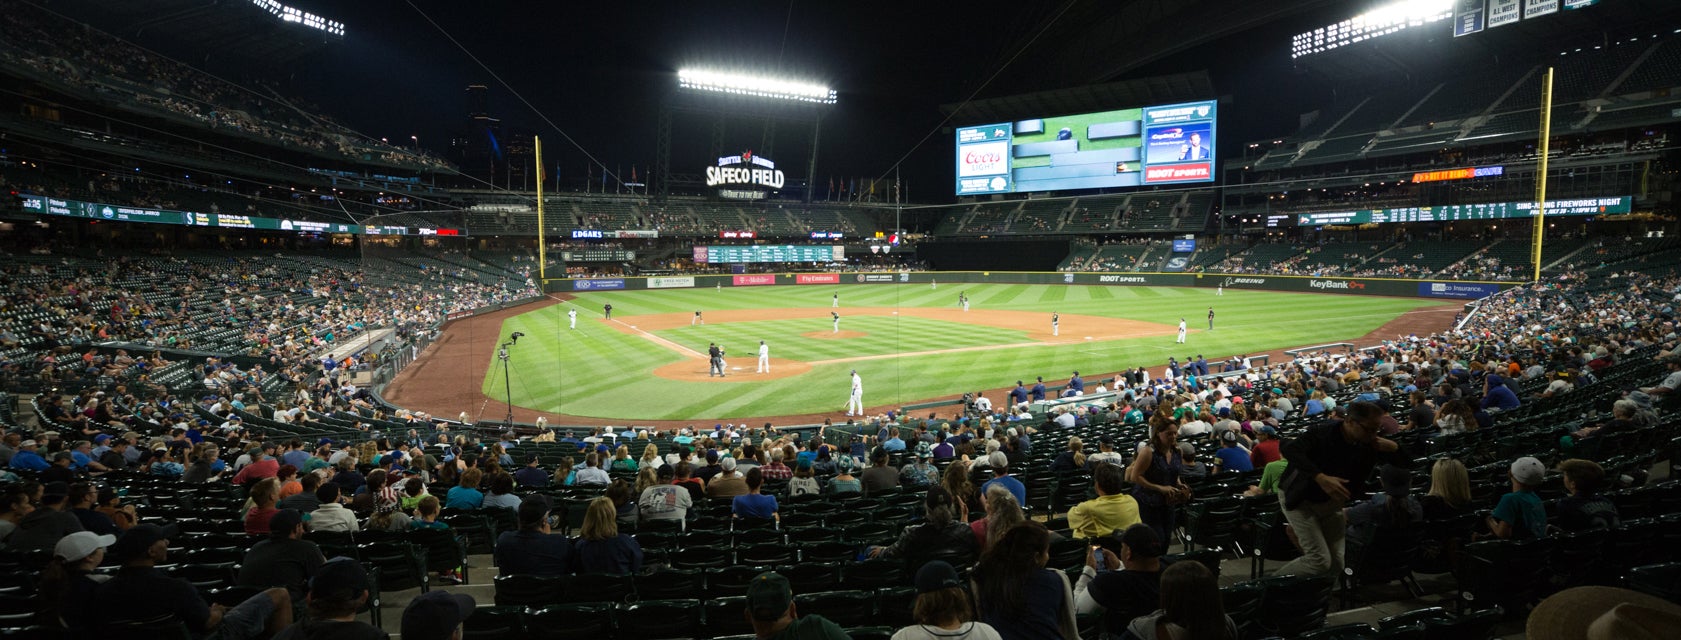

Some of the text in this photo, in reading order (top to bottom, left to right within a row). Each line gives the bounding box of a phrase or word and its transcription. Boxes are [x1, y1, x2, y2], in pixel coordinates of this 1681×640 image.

[1502, 4, 1516, 13] WEST
[1526, 2, 1557, 16] CHAMPIONS
[1490, 12, 1518, 24] CHAMPIONS
[966, 151, 1000, 164] Coors
[972, 163, 995, 171] LIGHT
[706, 166, 785, 189] SAFECO FIELD
[1147, 168, 1174, 178] ROOT
[1557, 199, 1597, 208] FIREWORKS
[1598, 198, 1621, 207] NIGHT
[1310, 279, 1348, 289] KeyBank
